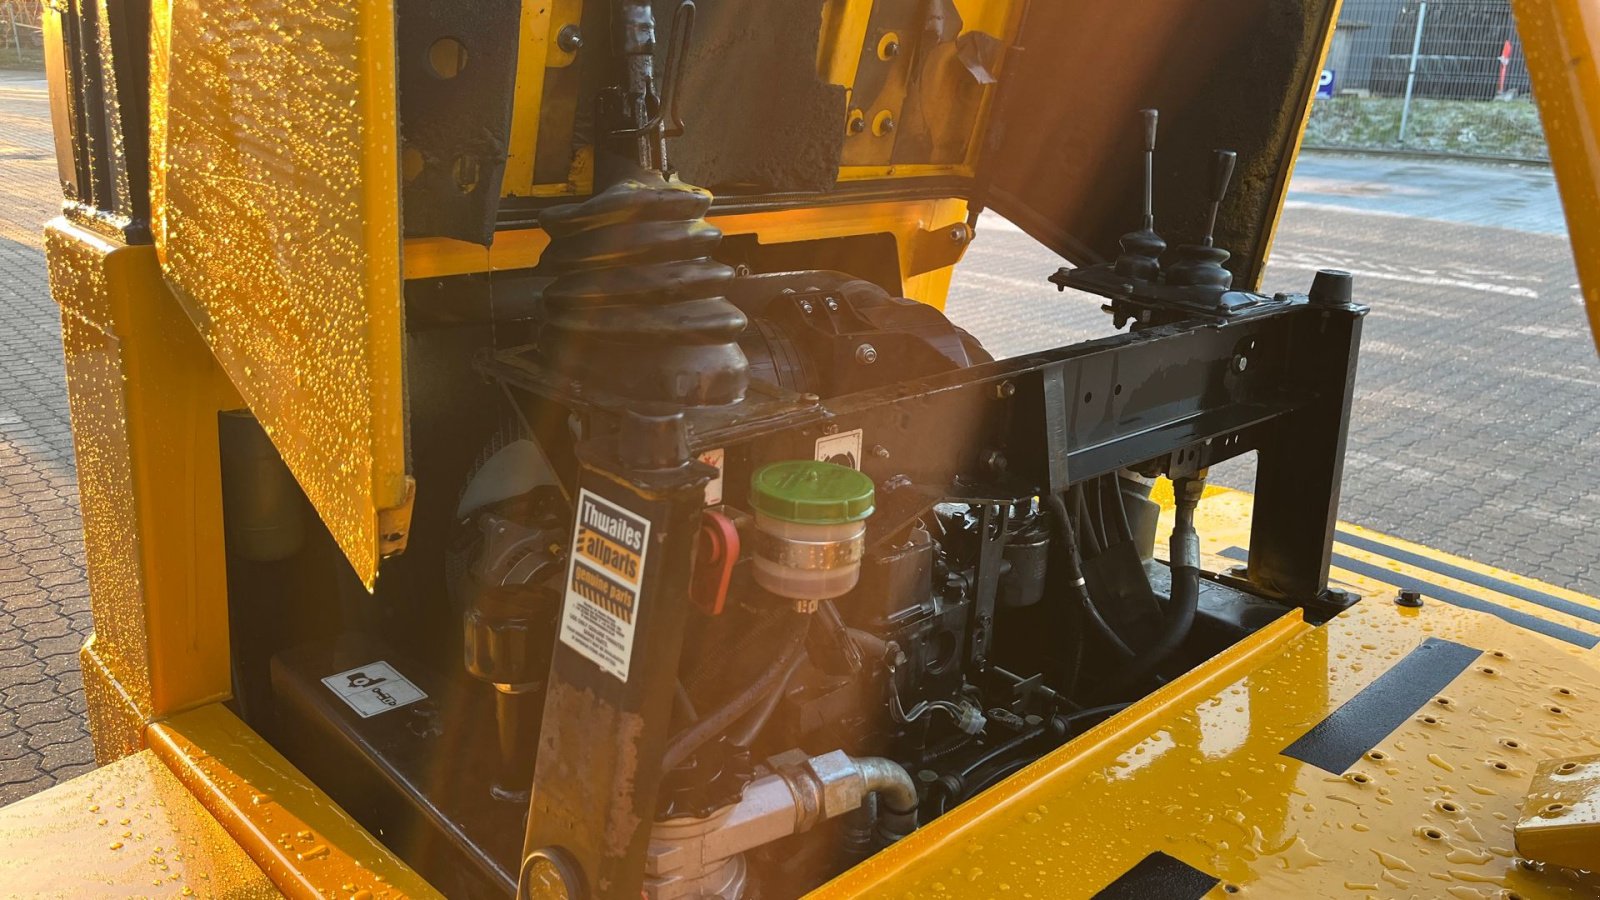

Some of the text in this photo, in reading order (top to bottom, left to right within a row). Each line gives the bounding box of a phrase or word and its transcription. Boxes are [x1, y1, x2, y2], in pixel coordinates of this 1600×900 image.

[583, 500, 642, 551] Thwaites
[586, 536, 638, 579] allparts
[575, 566, 633, 608] genuine parts
